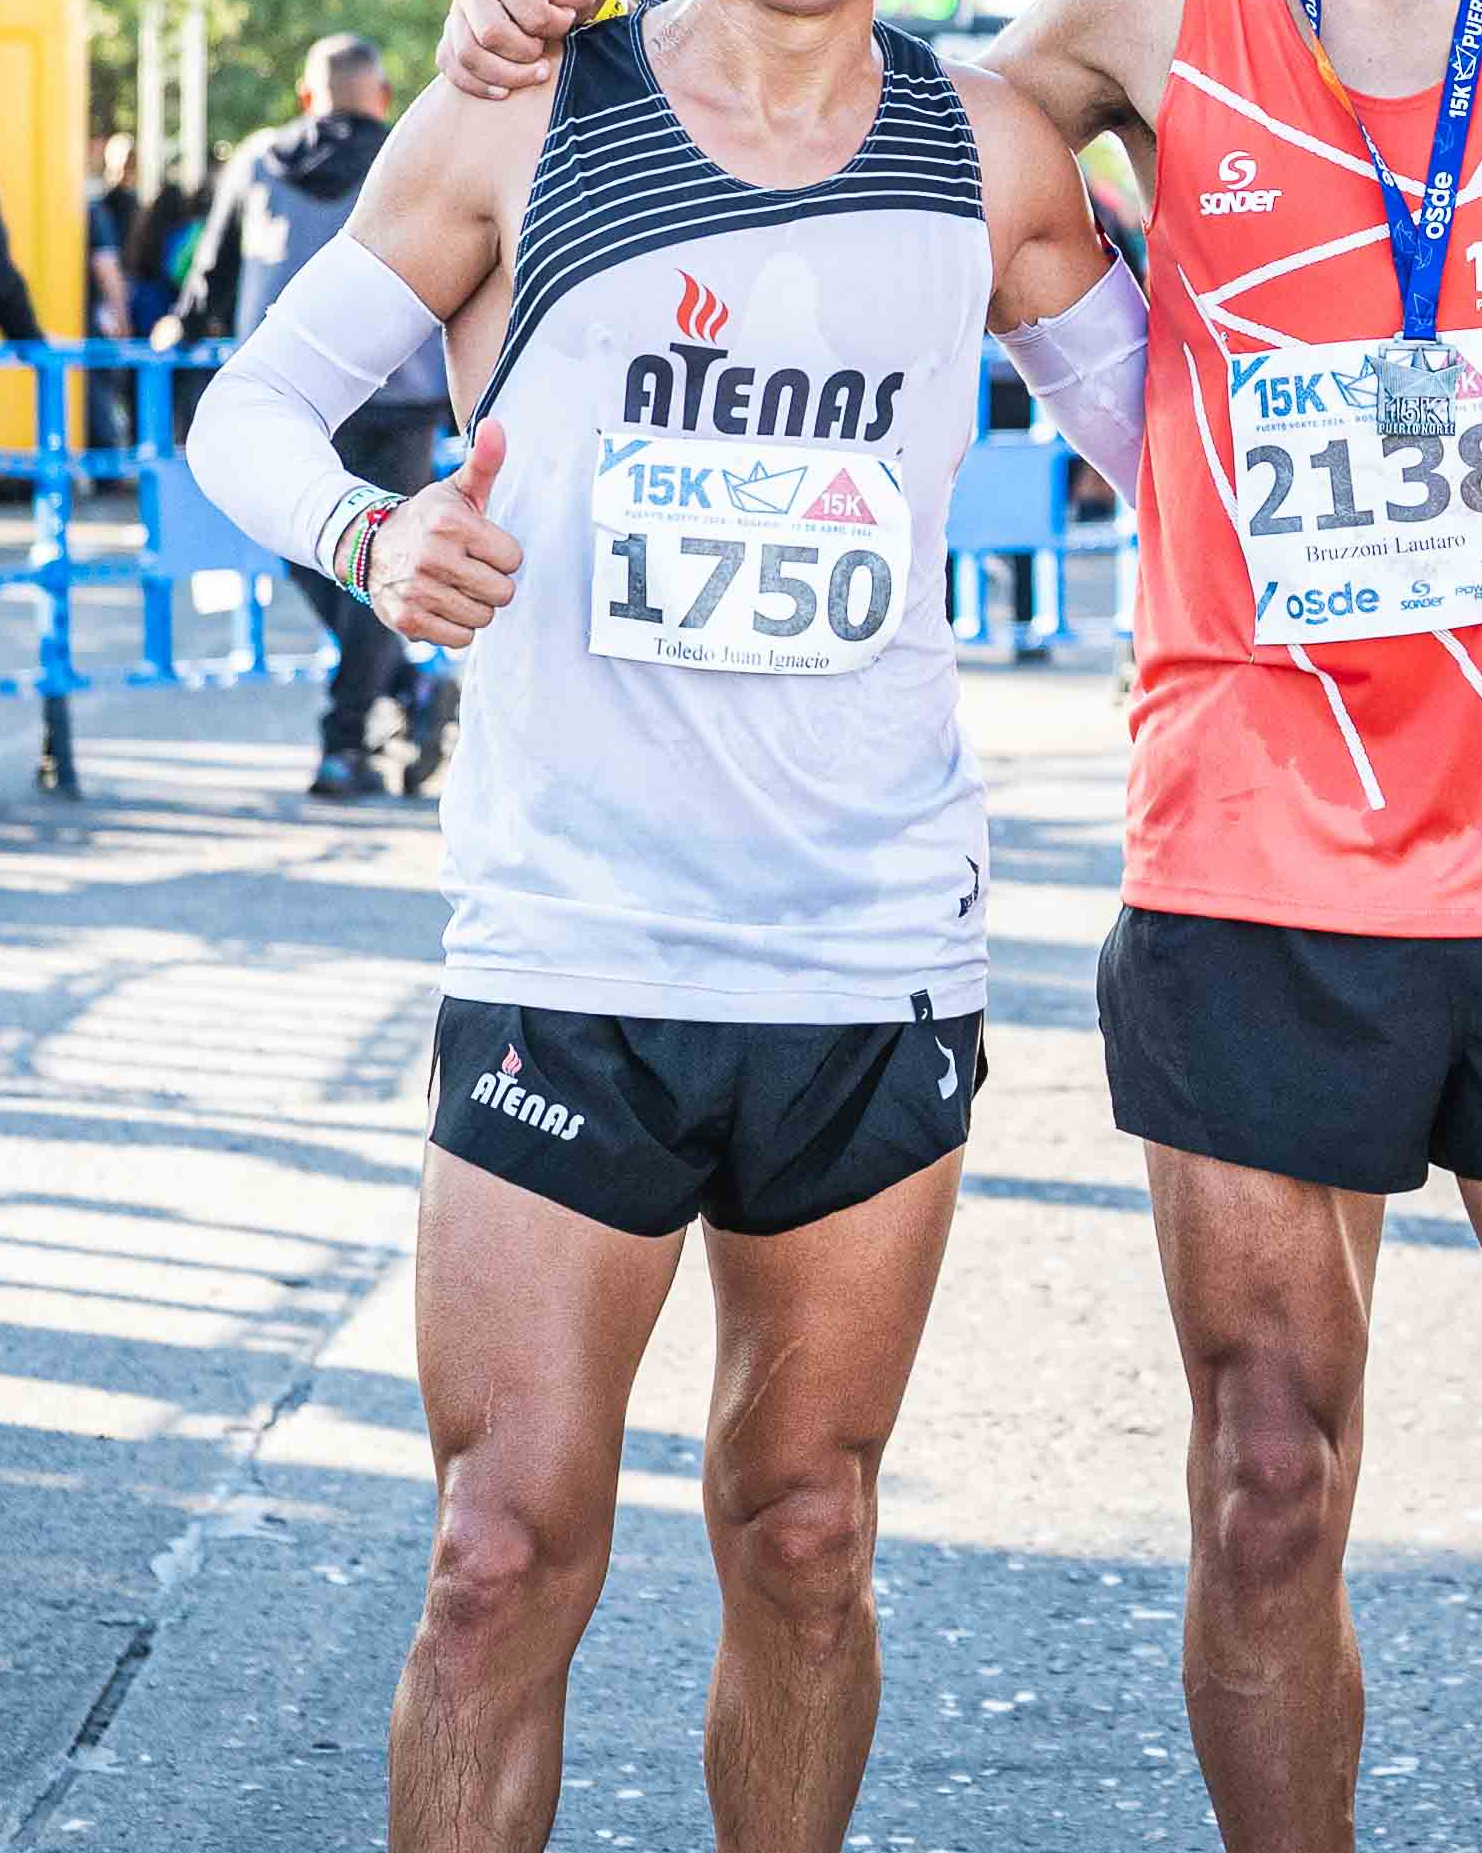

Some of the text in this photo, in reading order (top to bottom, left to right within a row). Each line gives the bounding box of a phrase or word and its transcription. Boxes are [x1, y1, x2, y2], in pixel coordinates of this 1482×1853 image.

[1449, 83, 1472, 117] 15K
[1425, 171, 1453, 240] osde
[622, 342, 904, 442] ATENAS
[1254, 374, 1328, 419] 15K
[627, 463, 715, 509] 15K
[820, 493, 863, 517] 15K
[1305, 533, 1467, 564] Bruzzoni Lautaro
[609, 532, 893, 642] 1750
[1286, 580, 1381, 623] osde
[653, 636, 831, 673] Toledo Juan Ignacio
[469, 1069, 585, 1141] ATENAS
